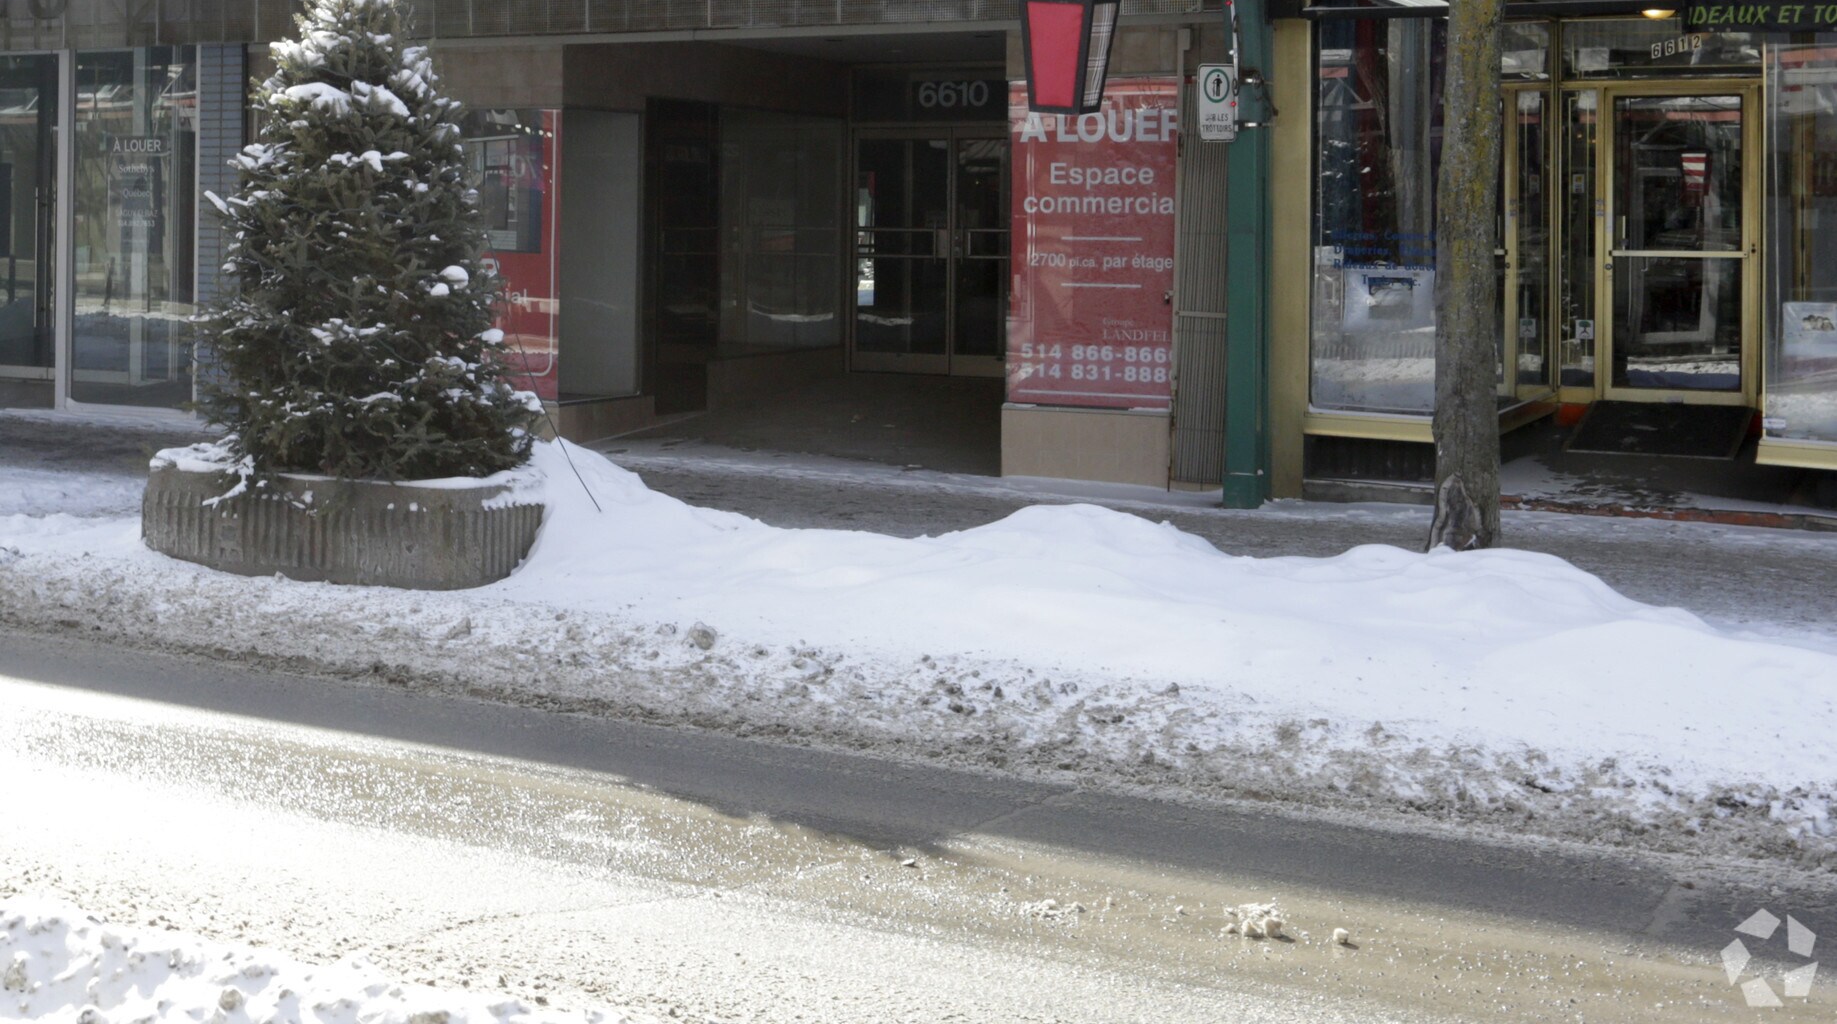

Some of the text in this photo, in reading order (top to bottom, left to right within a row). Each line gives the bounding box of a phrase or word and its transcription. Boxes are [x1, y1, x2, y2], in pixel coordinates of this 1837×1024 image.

[1778, 5, 1808, 23] ET
[1652, 35, 1701, 58] 6612
[918, 79, 989, 108] 6610
[113, 137, 161, 152] À LOUER
[1050, 162, 1154, 190] Espace
[1030, 253, 1066, 266] 2700
[1103, 256, 1127, 270] par
[1132, 253, 1174, 272] étage
[1385, 259, 1398, 271] de
[1021, 343, 1173, 363] 514 866-866
[1020, 362, 1173, 383] 514 831-888
